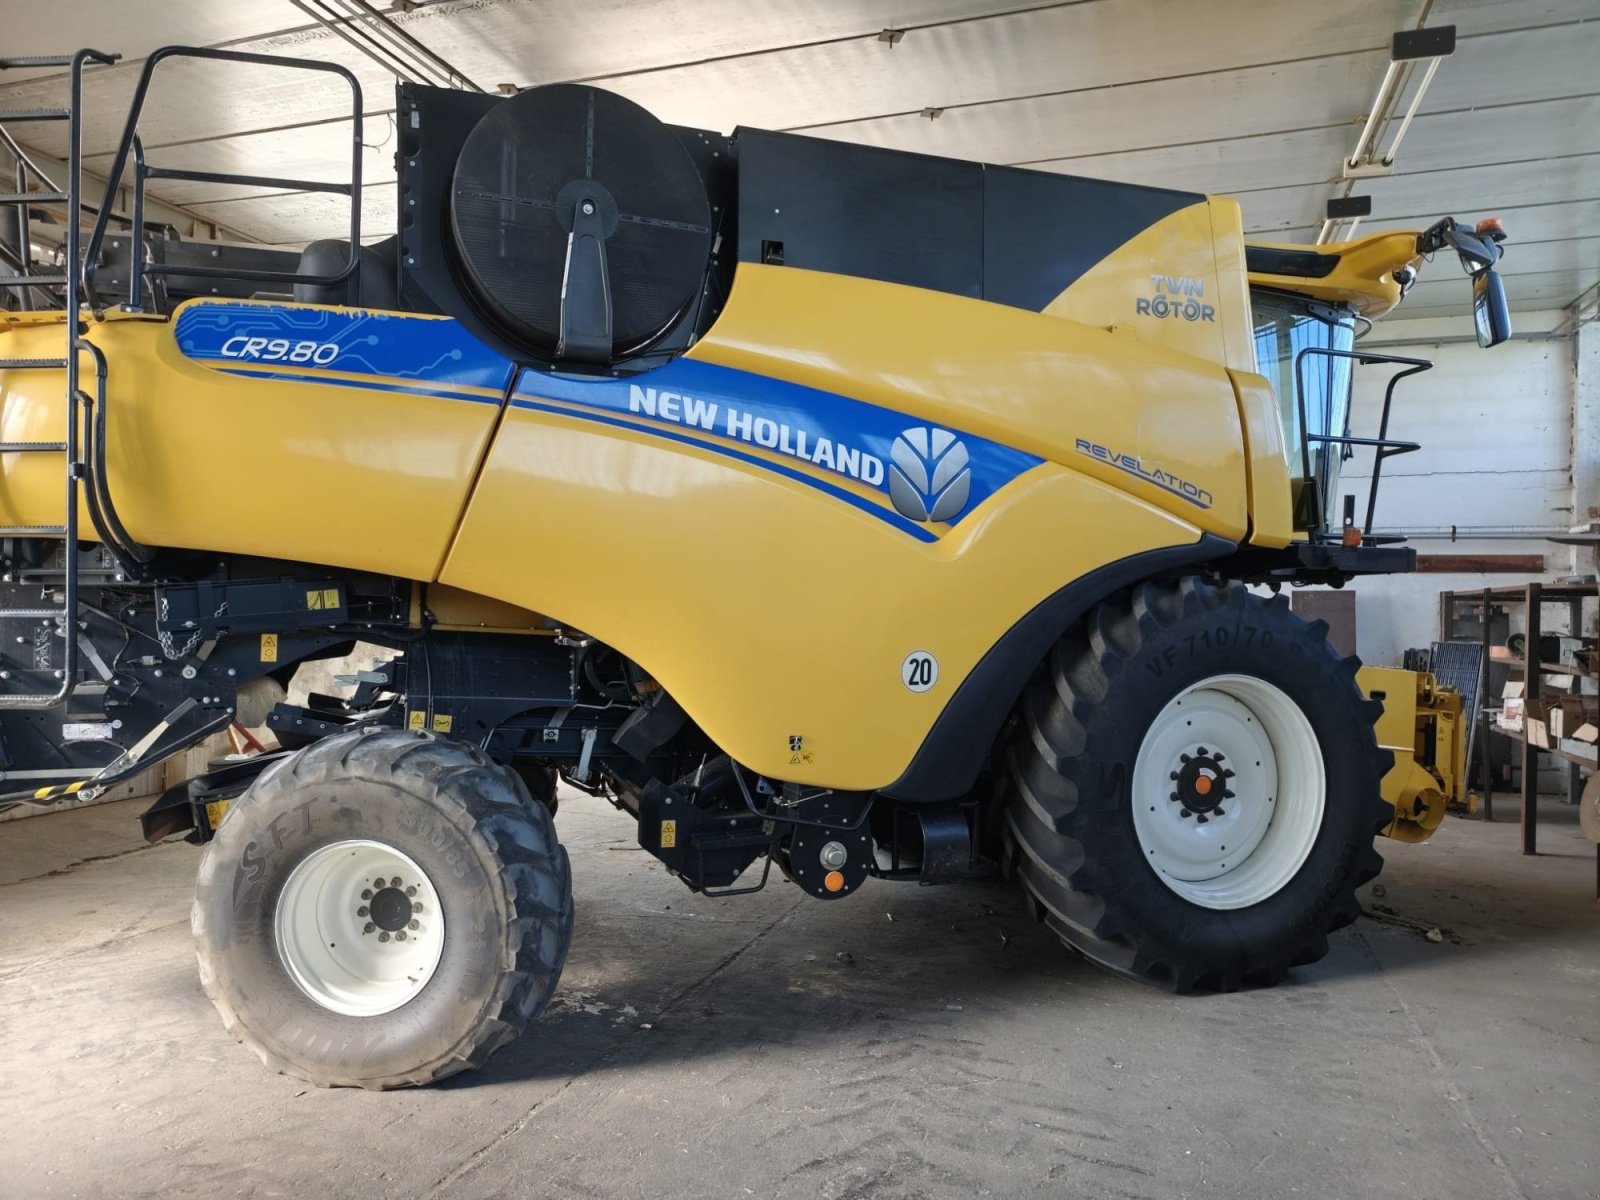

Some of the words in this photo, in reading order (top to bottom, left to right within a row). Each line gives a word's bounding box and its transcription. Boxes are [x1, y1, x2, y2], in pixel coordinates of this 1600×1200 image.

[1151, 274, 1204, 298] TWIN
[1136, 295, 1215, 322] ROTOR
[221, 336, 340, 365] CR9.80
[629, 384, 719, 431] NEW
[727, 408, 885, 487] HOLLAND
[1075, 437, 1213, 504] REVELATION
[1146, 646, 1177, 678] VF
[1183, 625, 1275, 656] 710/70
[908, 657, 932, 686] 20
